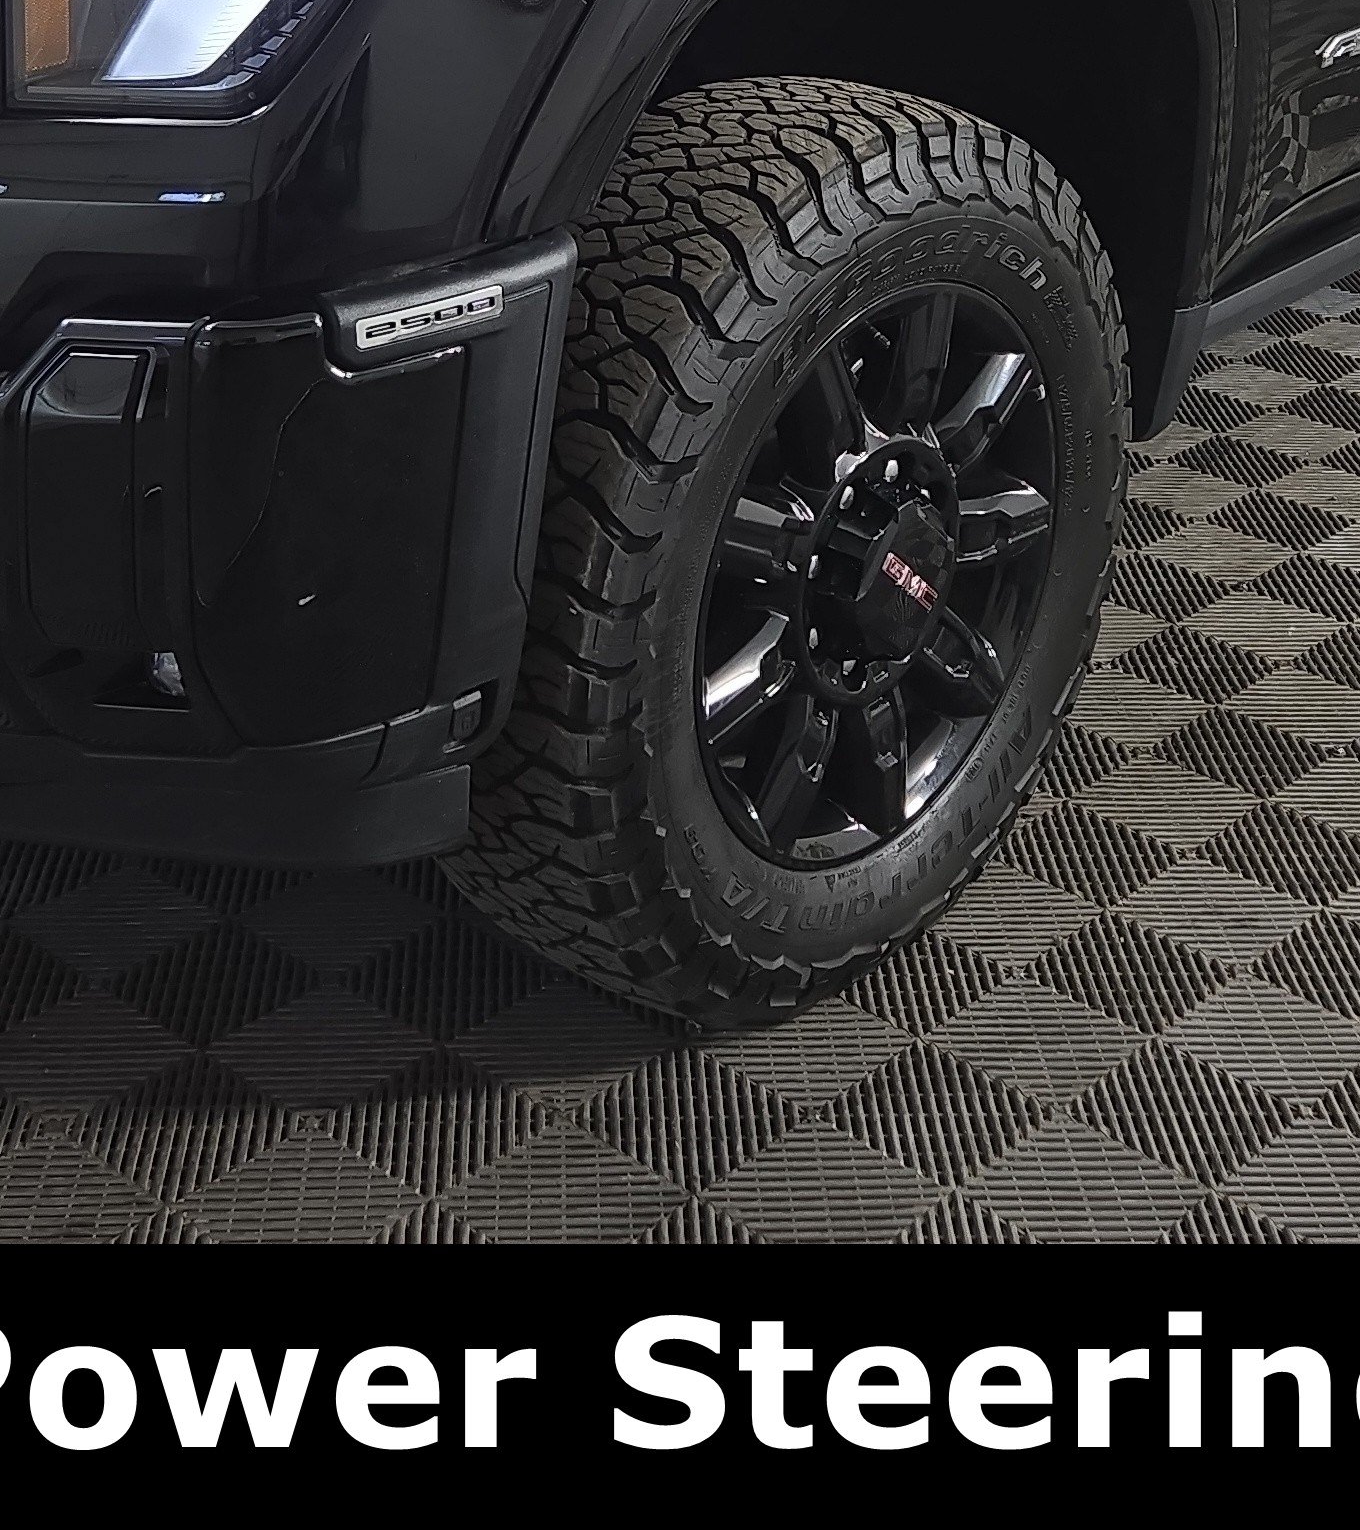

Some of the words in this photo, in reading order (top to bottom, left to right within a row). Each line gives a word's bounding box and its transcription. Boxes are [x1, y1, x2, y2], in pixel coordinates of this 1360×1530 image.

[364, 295, 497, 340] 2500
[765, 219, 1052, 389] BFGoodrich
[882, 551, 939, 614] GMC
